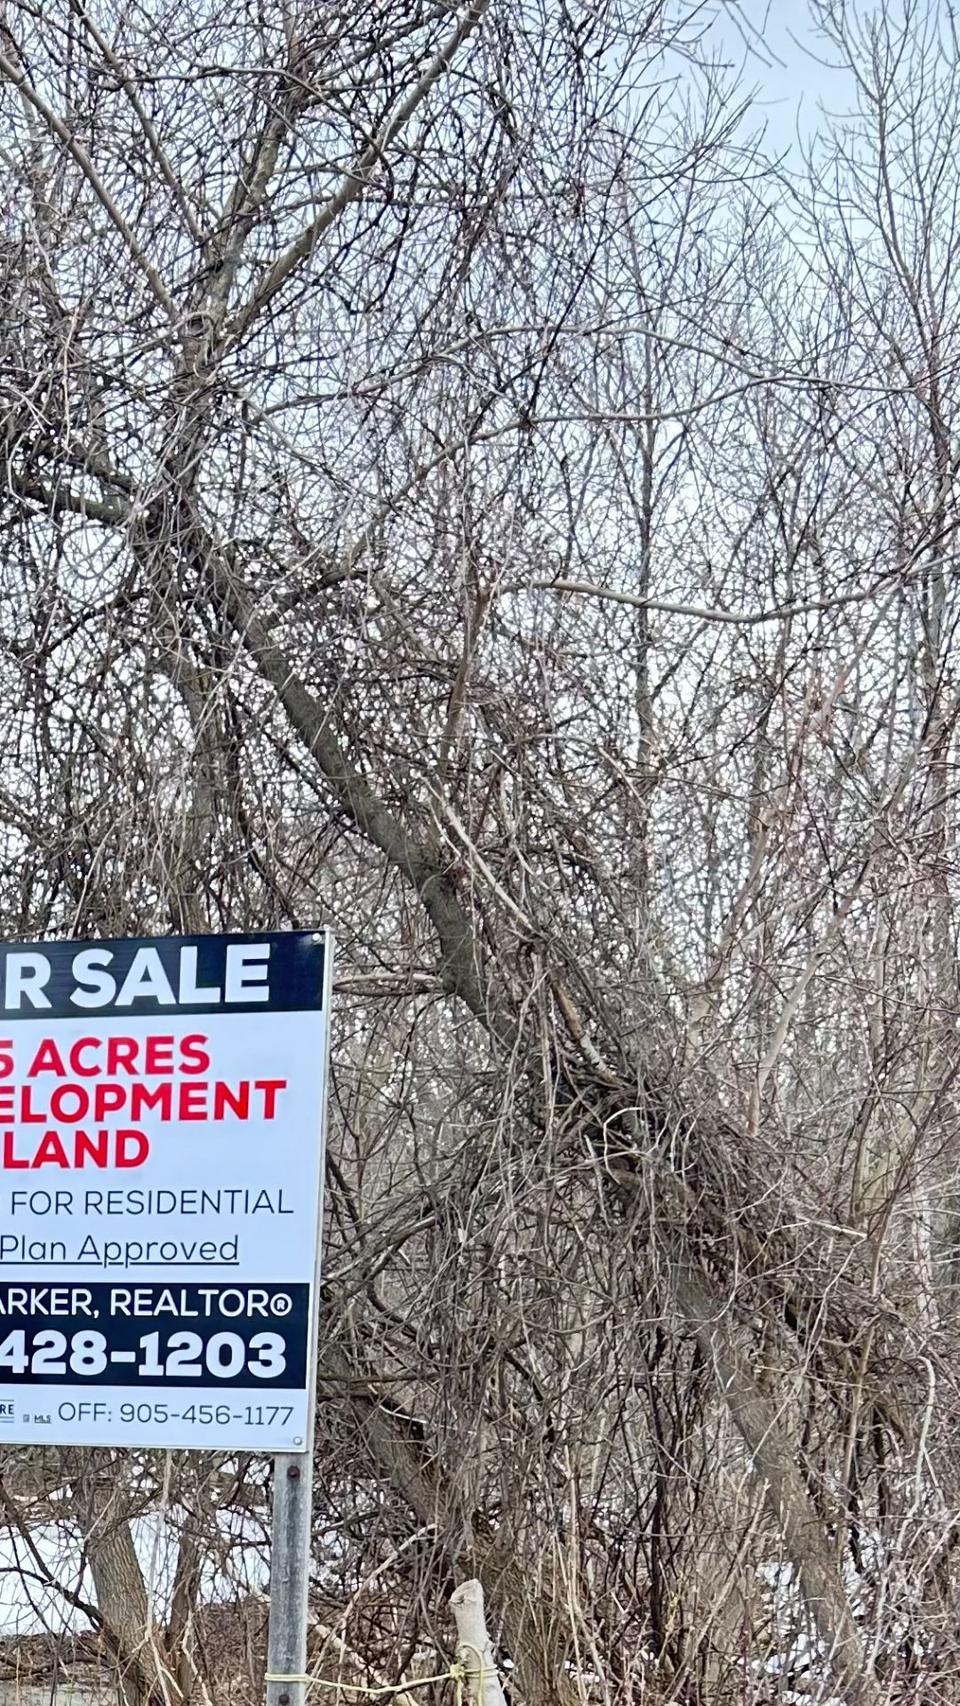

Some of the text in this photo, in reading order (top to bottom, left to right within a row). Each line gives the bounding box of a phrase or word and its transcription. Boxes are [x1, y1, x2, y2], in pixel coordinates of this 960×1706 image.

[70, 943, 271, 1008] SALE
[28, 1035, 210, 1077] ACRES
[3, 1130, 150, 1169] LAND
[11, 1190, 73, 1216] FOR
[84, 1189, 294, 1216] RESIDENTIAL
[0, 1235, 67, 1261] Plan
[77, 1234, 240, 1268] Approved
[58, 1402, 112, 1423] OFF:
[120, 1403, 294, 1426] 905-456-1177
